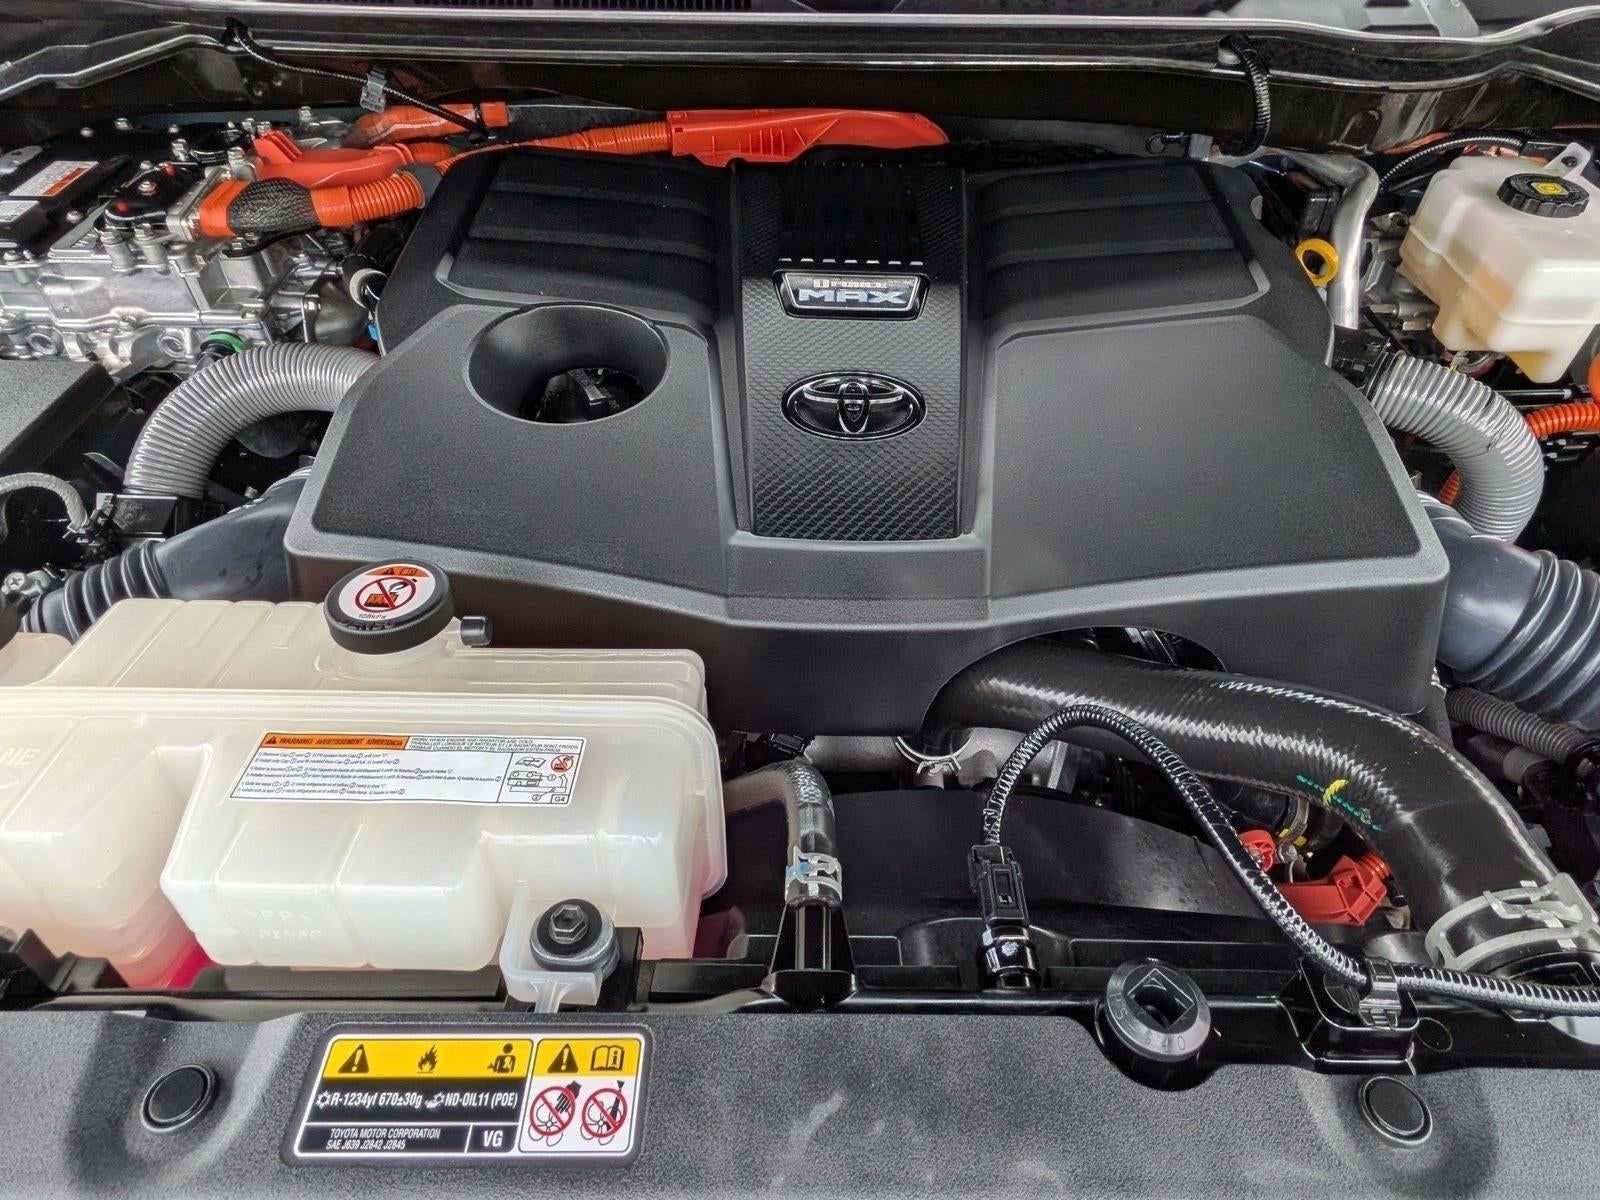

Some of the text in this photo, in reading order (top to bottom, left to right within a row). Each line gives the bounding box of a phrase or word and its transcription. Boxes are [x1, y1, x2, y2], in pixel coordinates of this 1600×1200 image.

[797, 288, 907, 304] MAX
[330, 1092, 518, 1109] R-1234yf 670±30g ND-OIL11 (POE)
[330, 1128, 441, 1139] TOYOTA MOTOR CORPORATION
[483, 1130, 504, 1147] VG
[326, 1140, 407, 1150] SAE J639 J2842 J2845
